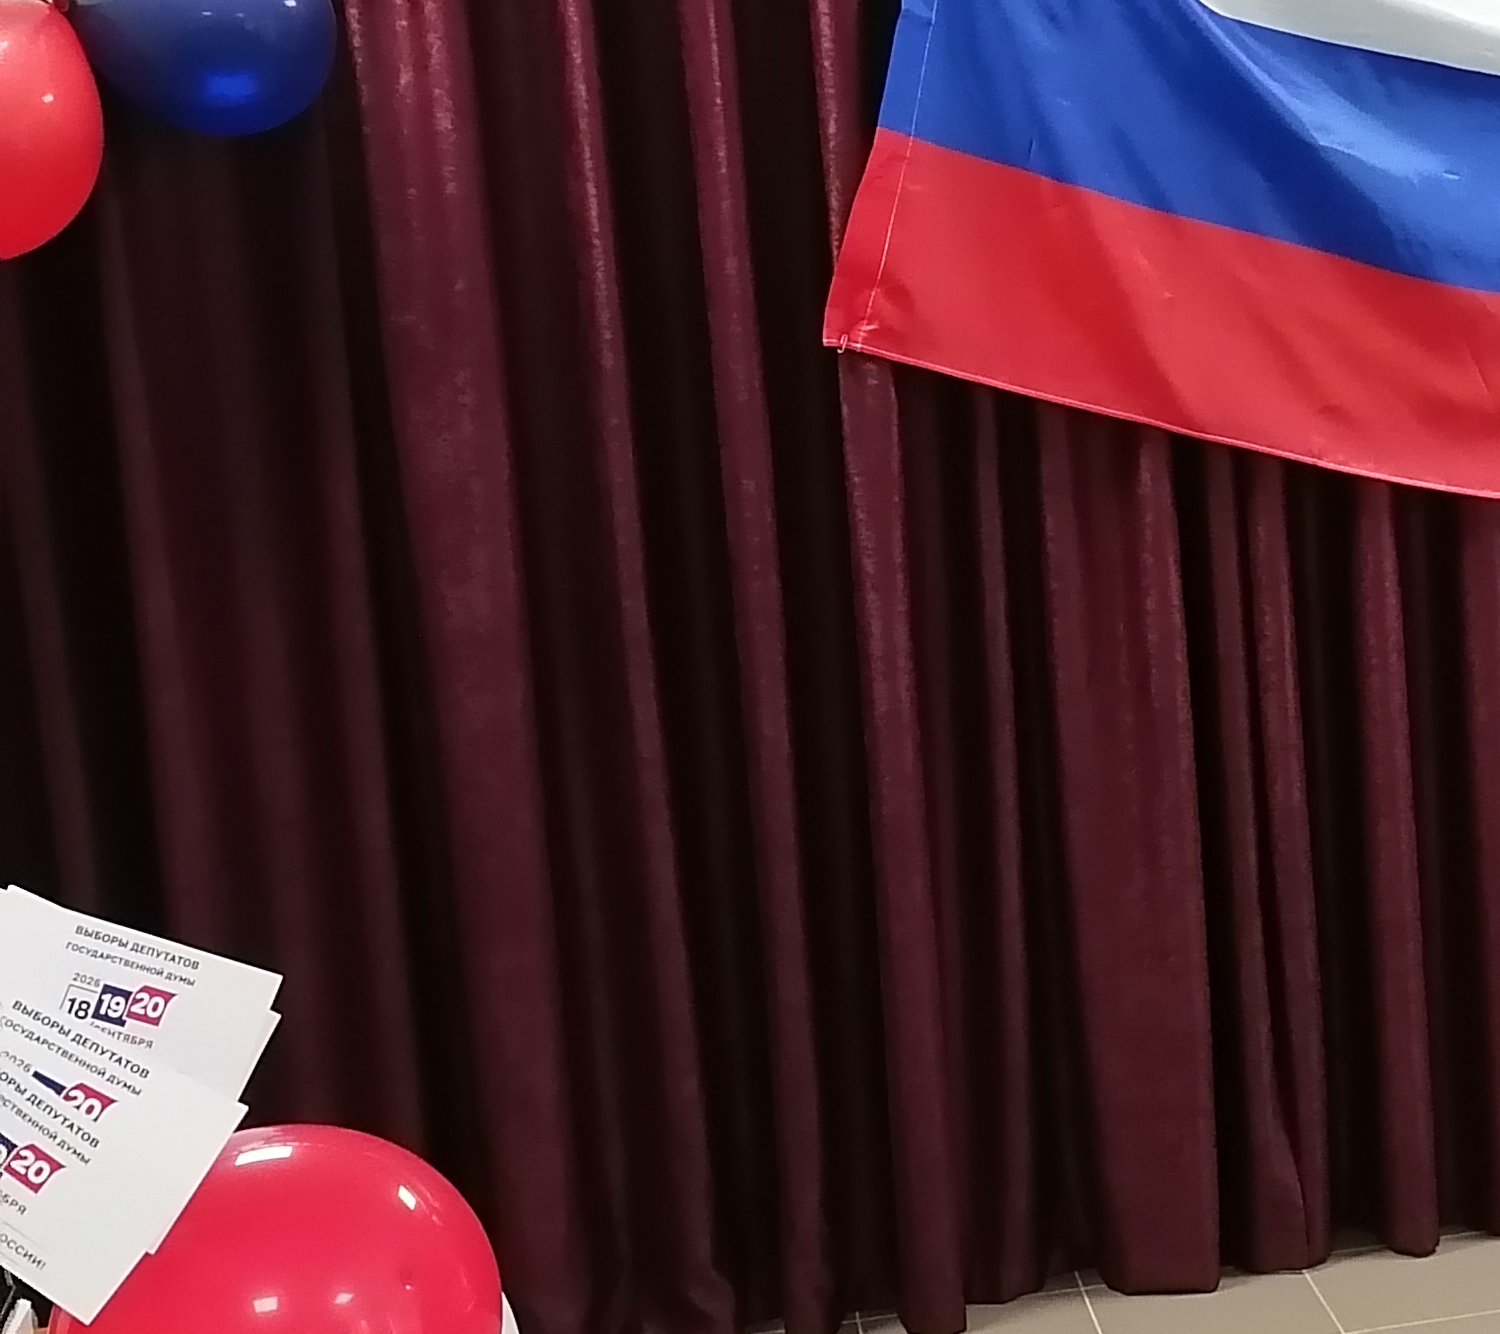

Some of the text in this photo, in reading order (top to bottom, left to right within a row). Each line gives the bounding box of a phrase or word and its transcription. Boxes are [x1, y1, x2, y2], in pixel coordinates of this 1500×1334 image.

[65, 941, 196, 986] ГОСУДАРСТВЕННОЙ ДУМЫ
[75, 925, 200, 971] ВЫБОРЫ ДЕПУТАТОВ
[67, 991, 166, 1020] 18 19 20
[12, 1000, 150, 1079] ВЫБОРЫ ДЕПУТАТОВ
[106, 1074, 142, 1096] ДУМЫ
[25, 1093, 100, 1149] ДЕПУТАТОВ
[9, 1149, 51, 1184] 20
[56, 1139, 91, 1165] ДУМЫ
